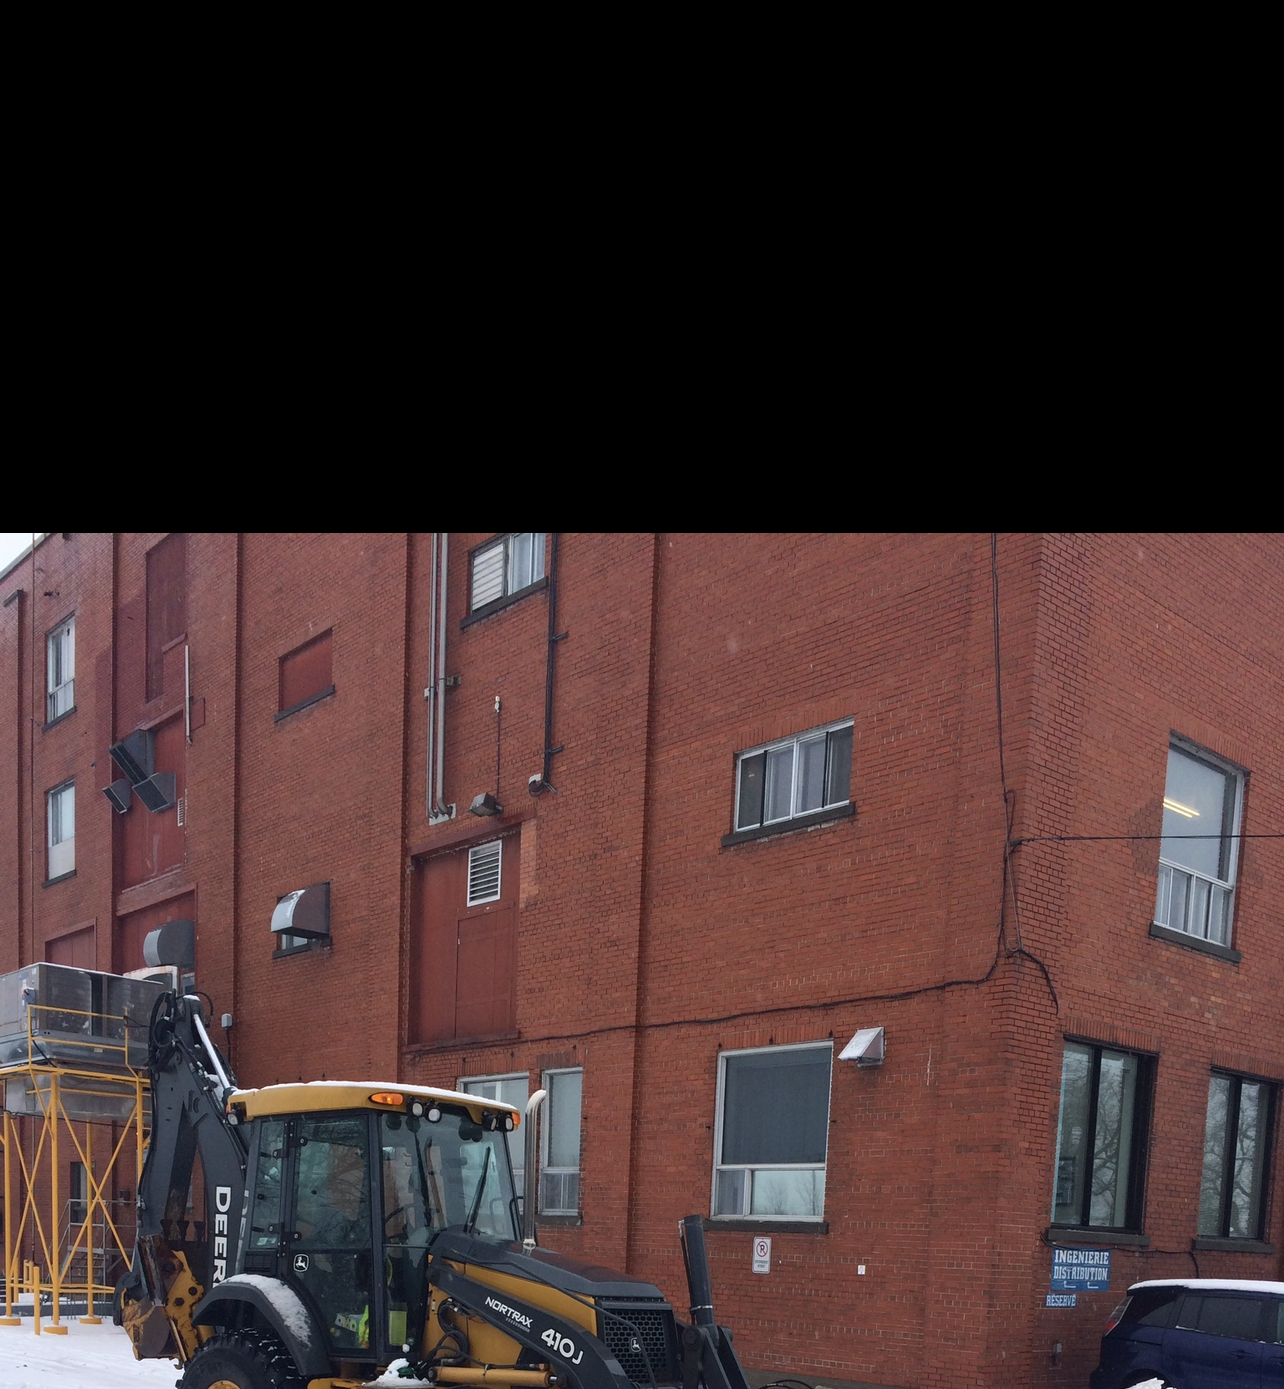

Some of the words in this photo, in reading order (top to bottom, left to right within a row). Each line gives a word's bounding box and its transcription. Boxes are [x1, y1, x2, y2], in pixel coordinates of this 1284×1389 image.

[213, 1186, 231, 1288] DEER
[1054, 1249, 1109, 1264] INGENIERIE
[1053, 1265, 1108, 1281] DISTRIBUTION
[484, 1296, 534, 1328] NORTRAX
[541, 1328, 584, 1365] 410J
